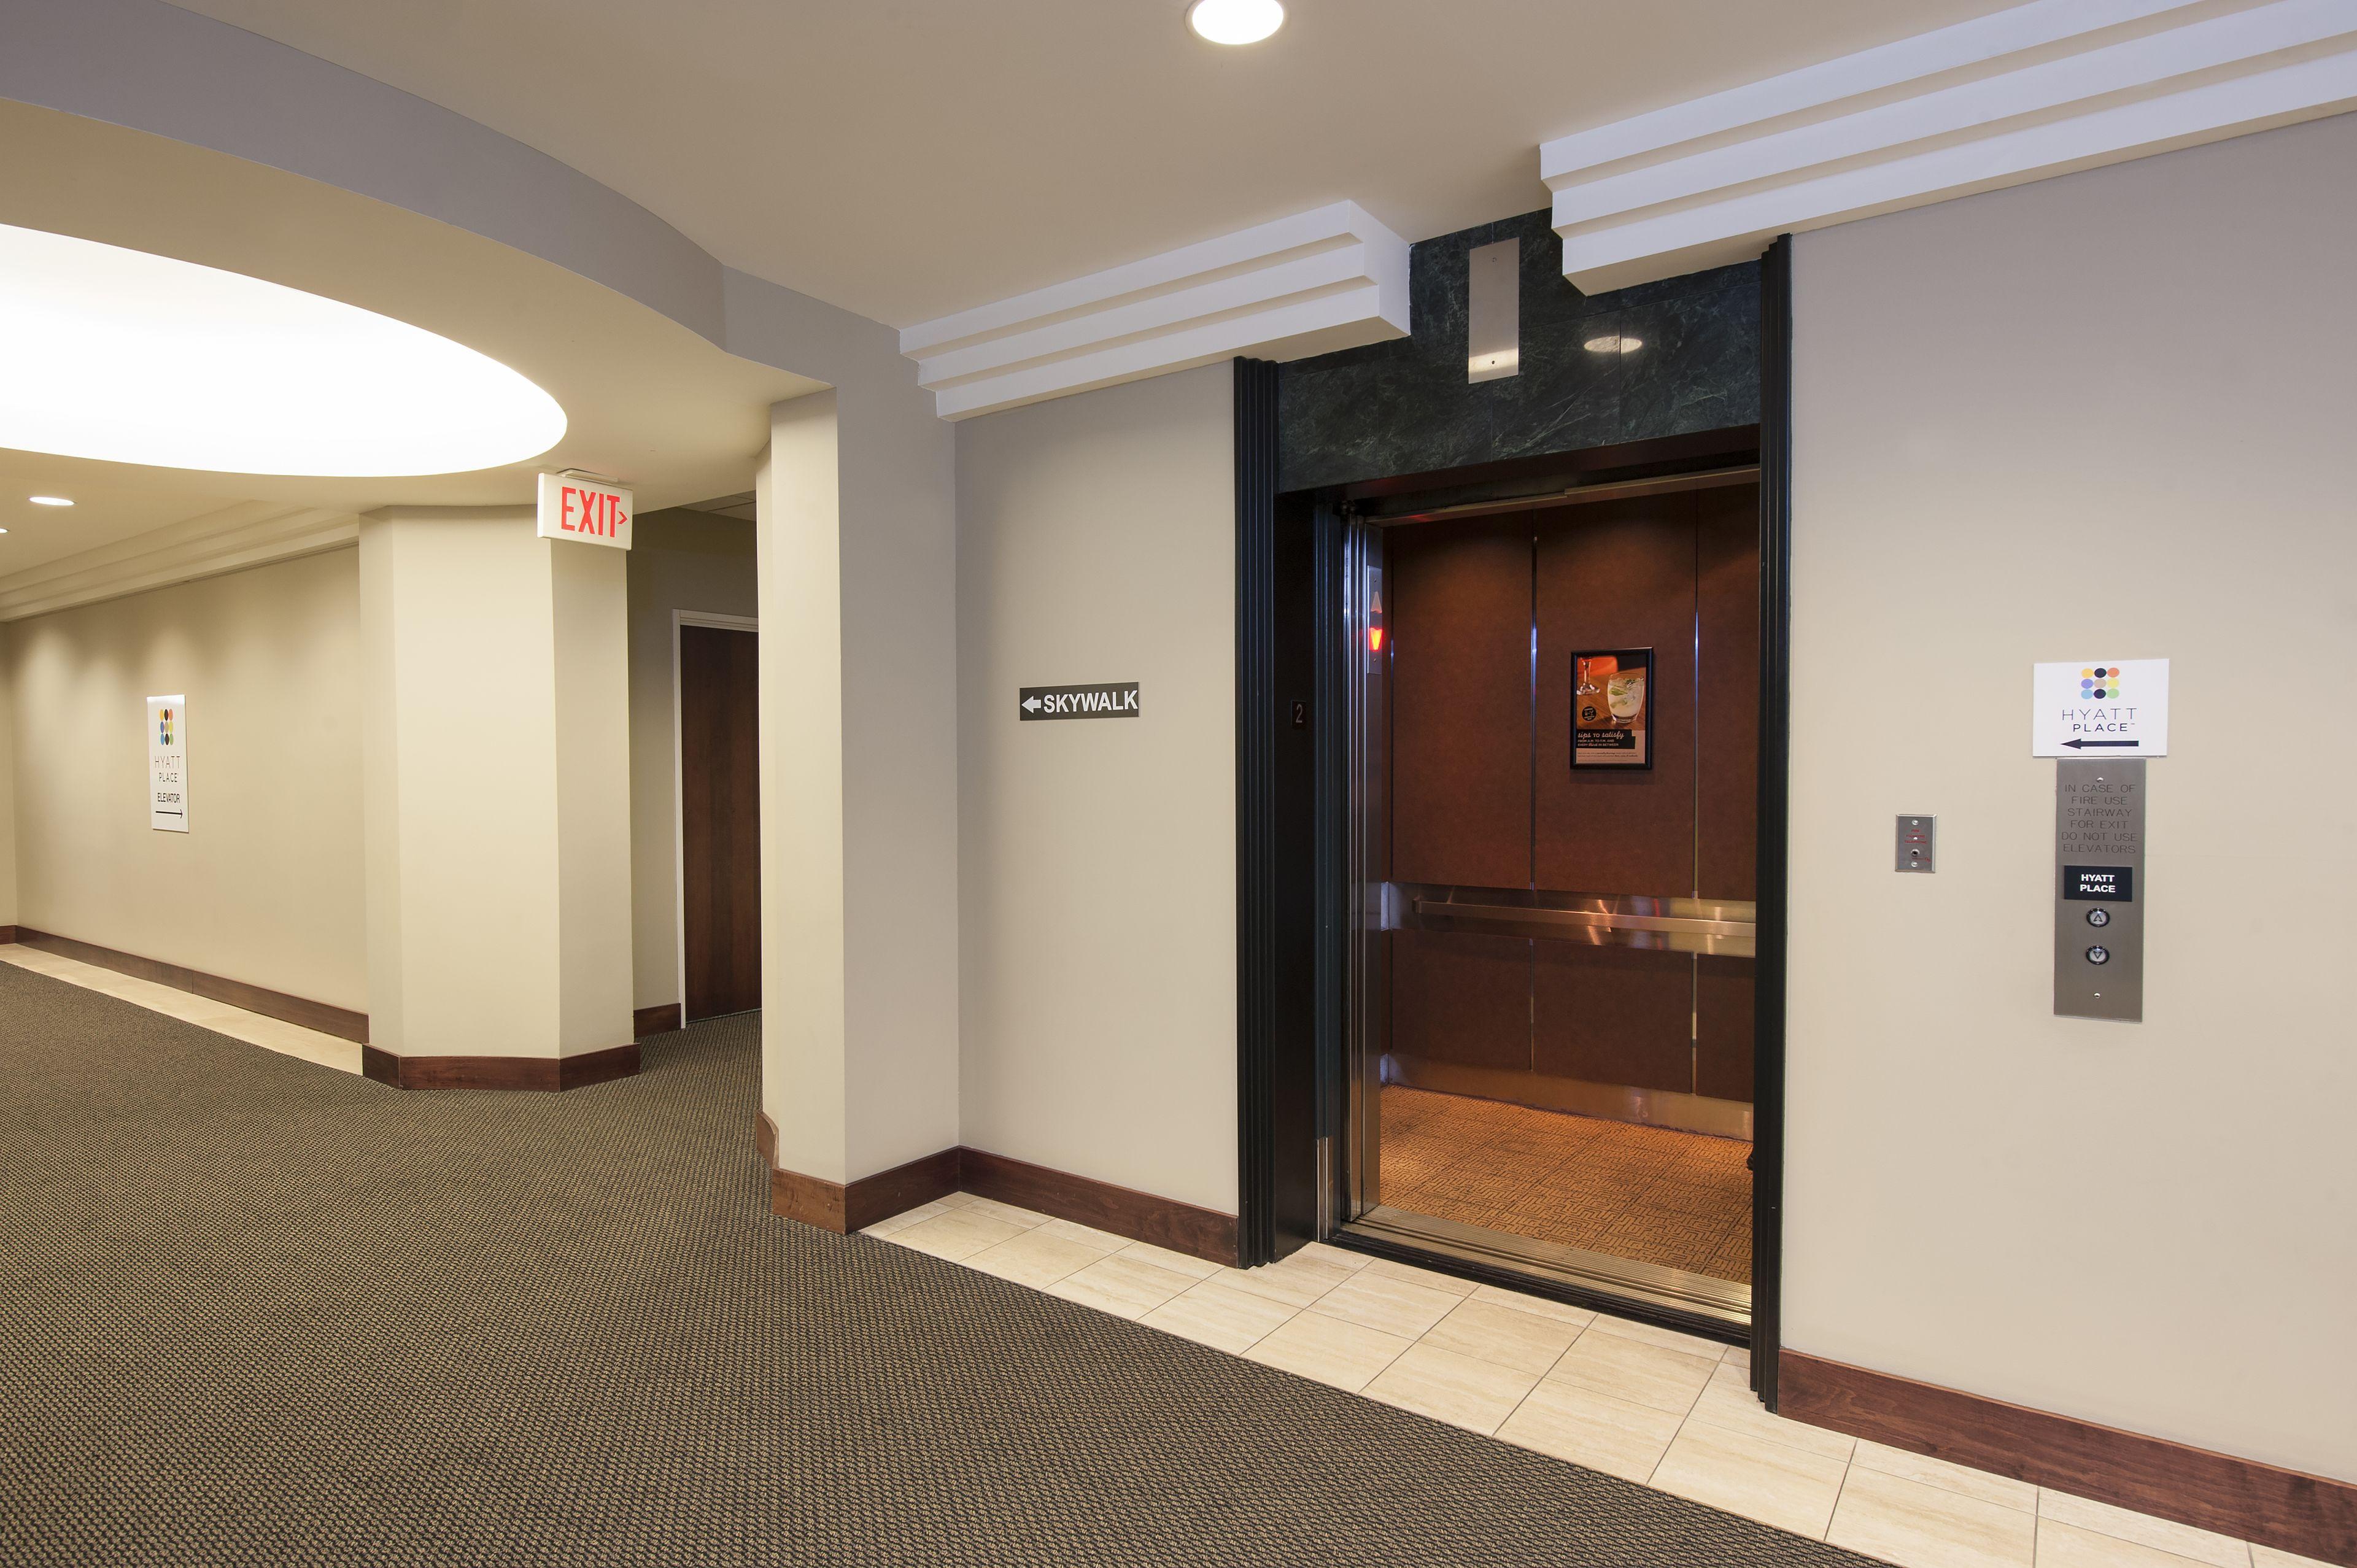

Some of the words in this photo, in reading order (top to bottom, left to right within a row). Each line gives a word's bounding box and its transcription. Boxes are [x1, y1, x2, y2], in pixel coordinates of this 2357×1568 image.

[561, 486, 621, 538] EXIT
[1043, 690, 1139, 714] SKYWALK
[1296, 703, 1302, 723] 2
[2062, 708, 2137, 720] HYATT
[1601, 730, 1625, 740] satisfy
[154, 755, 180, 769] HYATT
[159, 772, 178, 782] PLACE
[2082, 784, 2113, 793] CASE
[2120, 784, 2136, 793] OF
[157, 792, 180, 803] ELEVATOR
[2071, 796, 2097, 805] FIRE
[2104, 796, 2127, 805] USE
[2067, 808, 2132, 817] STAIRWAY
[2070, 820, 2094, 828] FOR
[2100, 821, 2128, 829] EXIT
[2061, 832, 2077, 840] DO
[2083, 832, 2107, 841] NOT
[2114, 833, 2138, 841] USE
[2063, 843, 2136, 854] ELEVATORS
[2081, 874, 2115, 882] HYATT
[2080, 884, 2116, 892] PLACE
